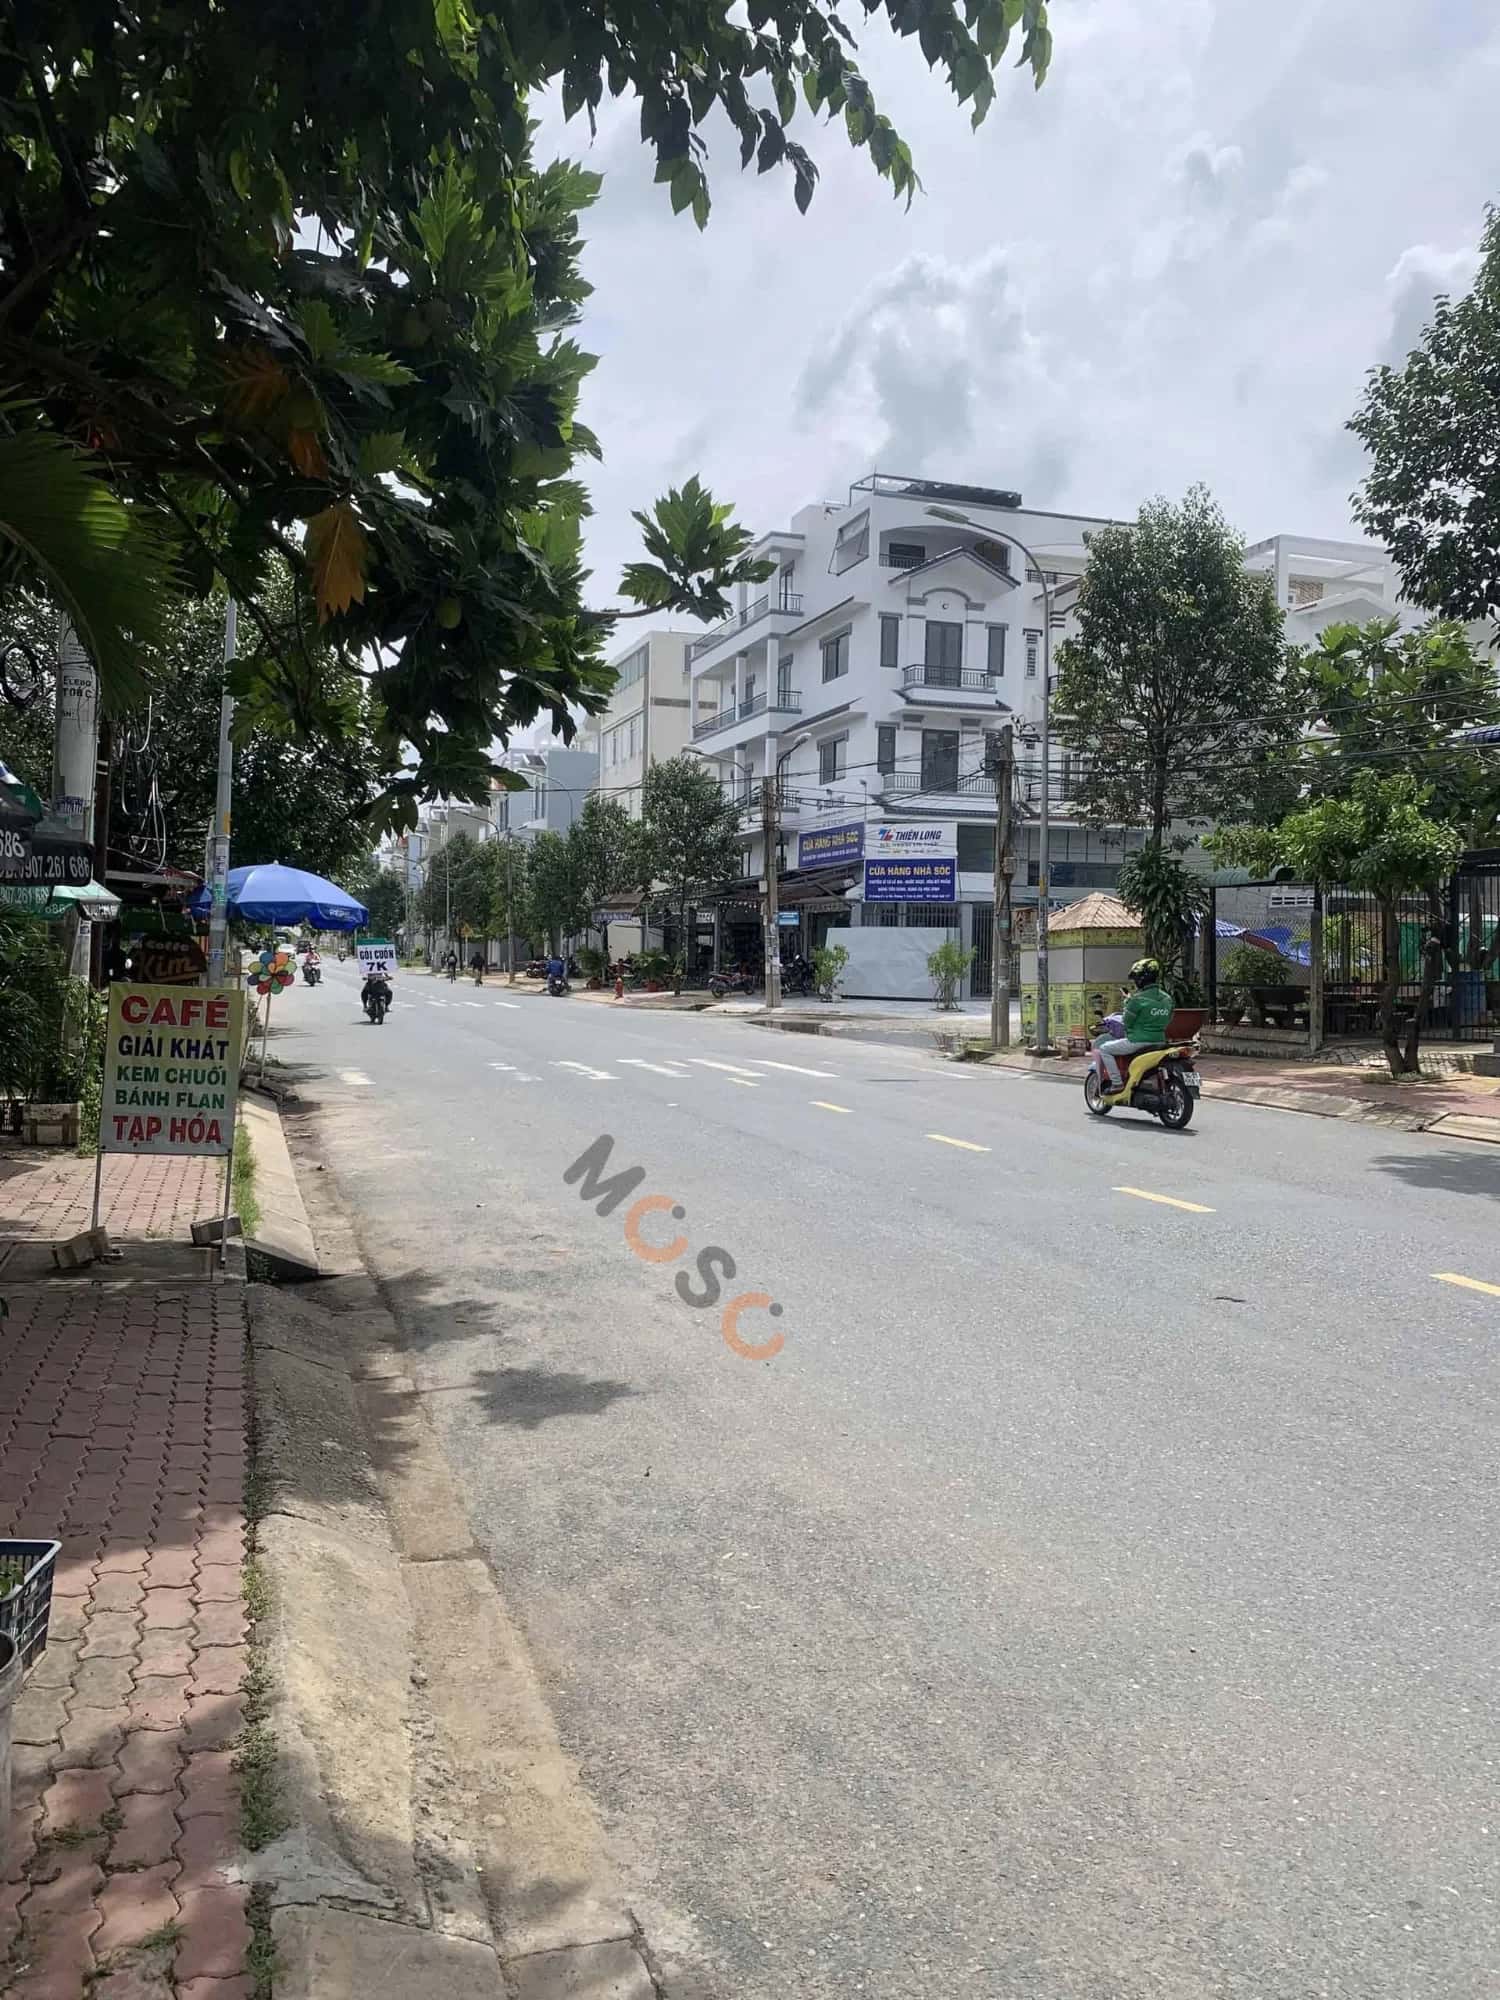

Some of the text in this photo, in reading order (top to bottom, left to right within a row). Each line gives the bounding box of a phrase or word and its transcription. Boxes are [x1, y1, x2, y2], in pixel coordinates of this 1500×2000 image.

[921, 830, 942, 841] LONG
[69, 856, 90, 879] 686
[887, 864, 912, 876] HÀNG
[913, 864, 932, 876] NHÀ
[366, 961, 388, 972] 7K
[121, 994, 229, 1029] CAFÉ
[118, 1030, 229, 1061] GIẢI KHÁT
[117, 1065, 226, 1086] KEM CHUỐI
[115, 1087, 225, 1109] BÁNH FLAN
[113, 1112, 222, 1147] TẠP HÓA
